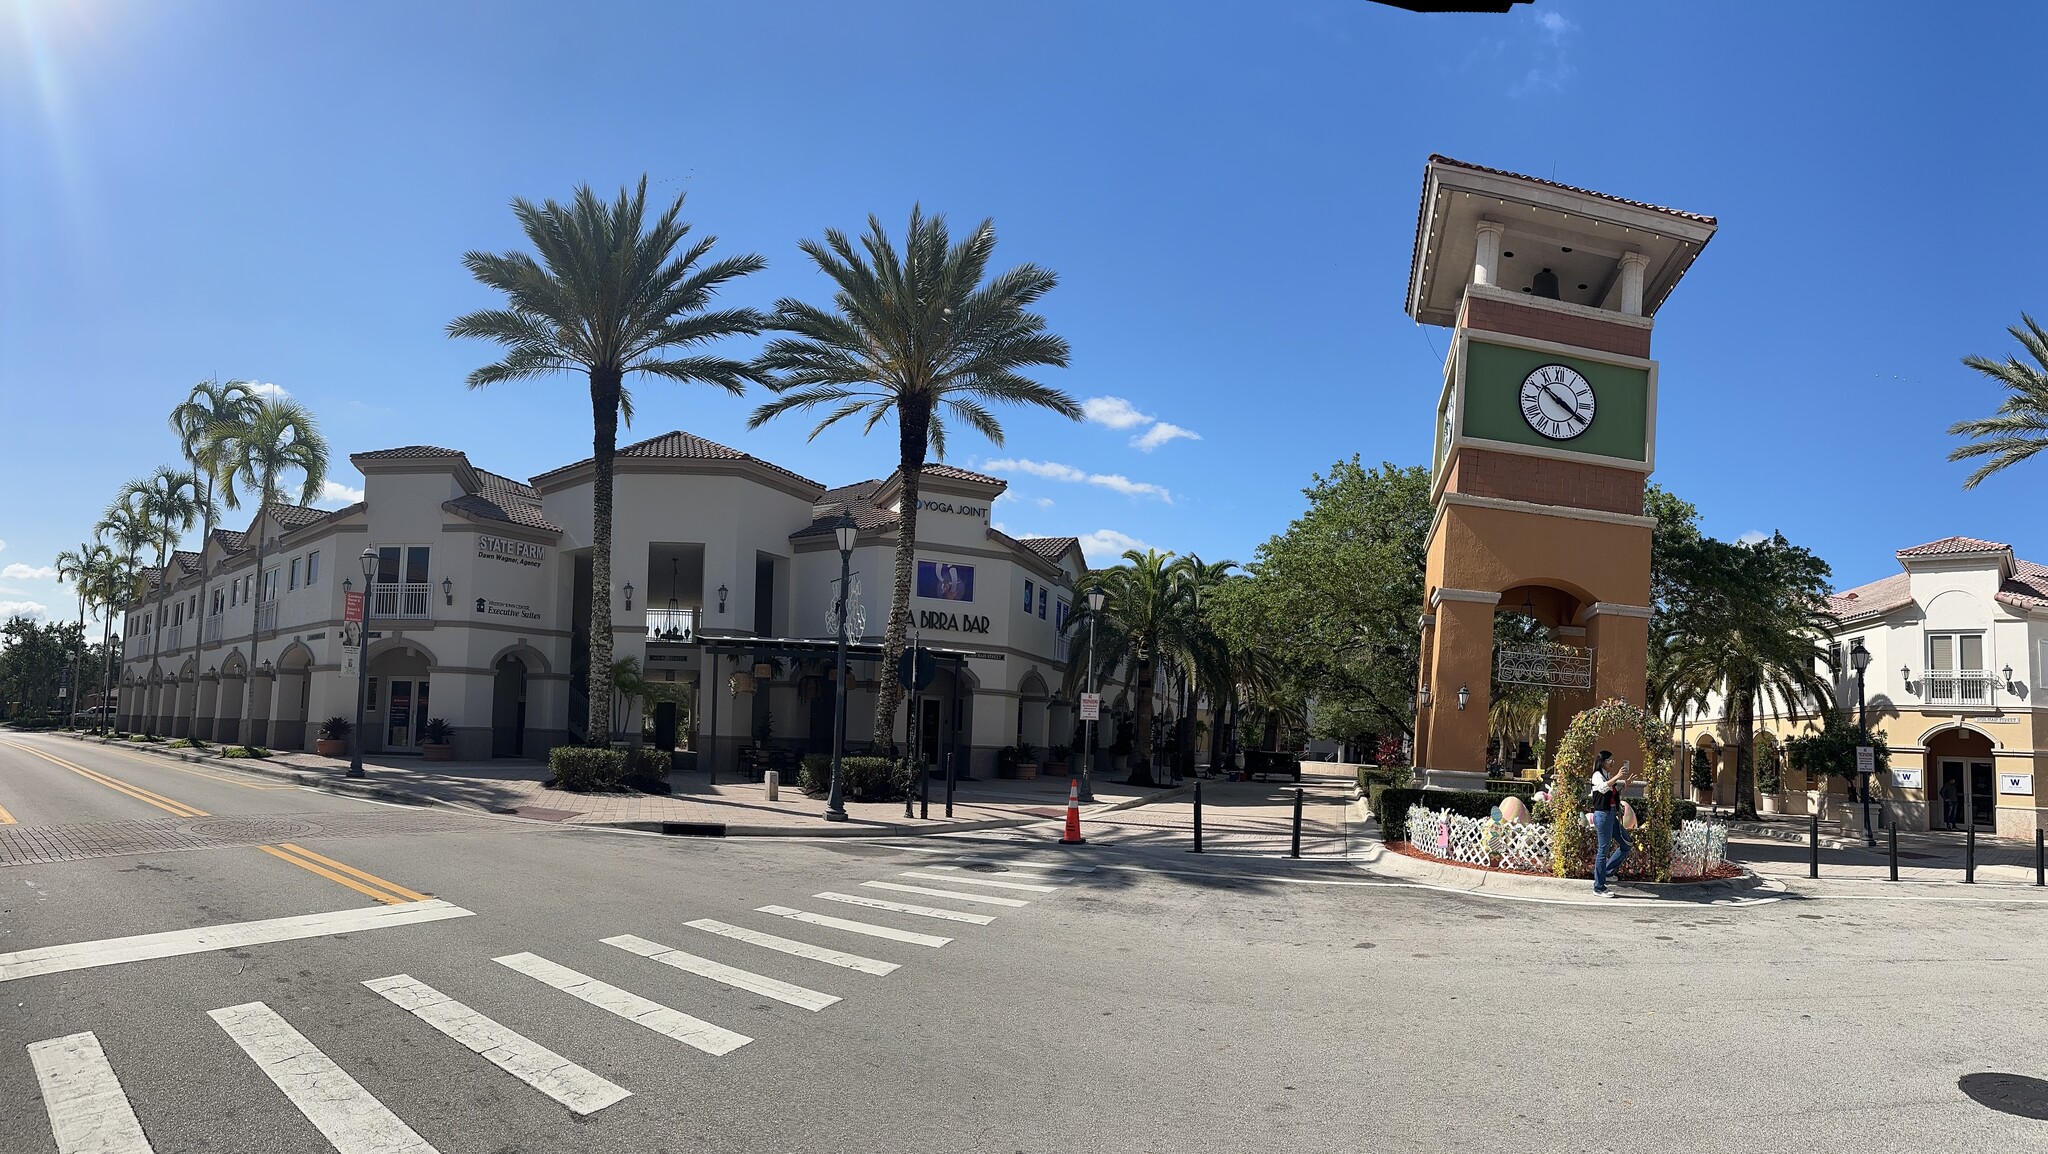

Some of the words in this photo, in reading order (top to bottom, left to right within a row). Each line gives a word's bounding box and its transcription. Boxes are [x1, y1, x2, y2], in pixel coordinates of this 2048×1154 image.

[923, 500, 954, 514] YOGA
[957, 505, 988, 518] JOINT
[479, 535, 514, 554] STATE
[516, 542, 545, 560] FARM
[478, 551, 495, 559] Dawn
[496, 554, 519, 564] Wagner,
[519, 559, 541, 568] Agency
[488, 606, 520, 617] Executive
[521, 610, 541, 620] Suites
[920, 609, 959, 632] BIRRA
[963, 614, 990, 634] BAR
